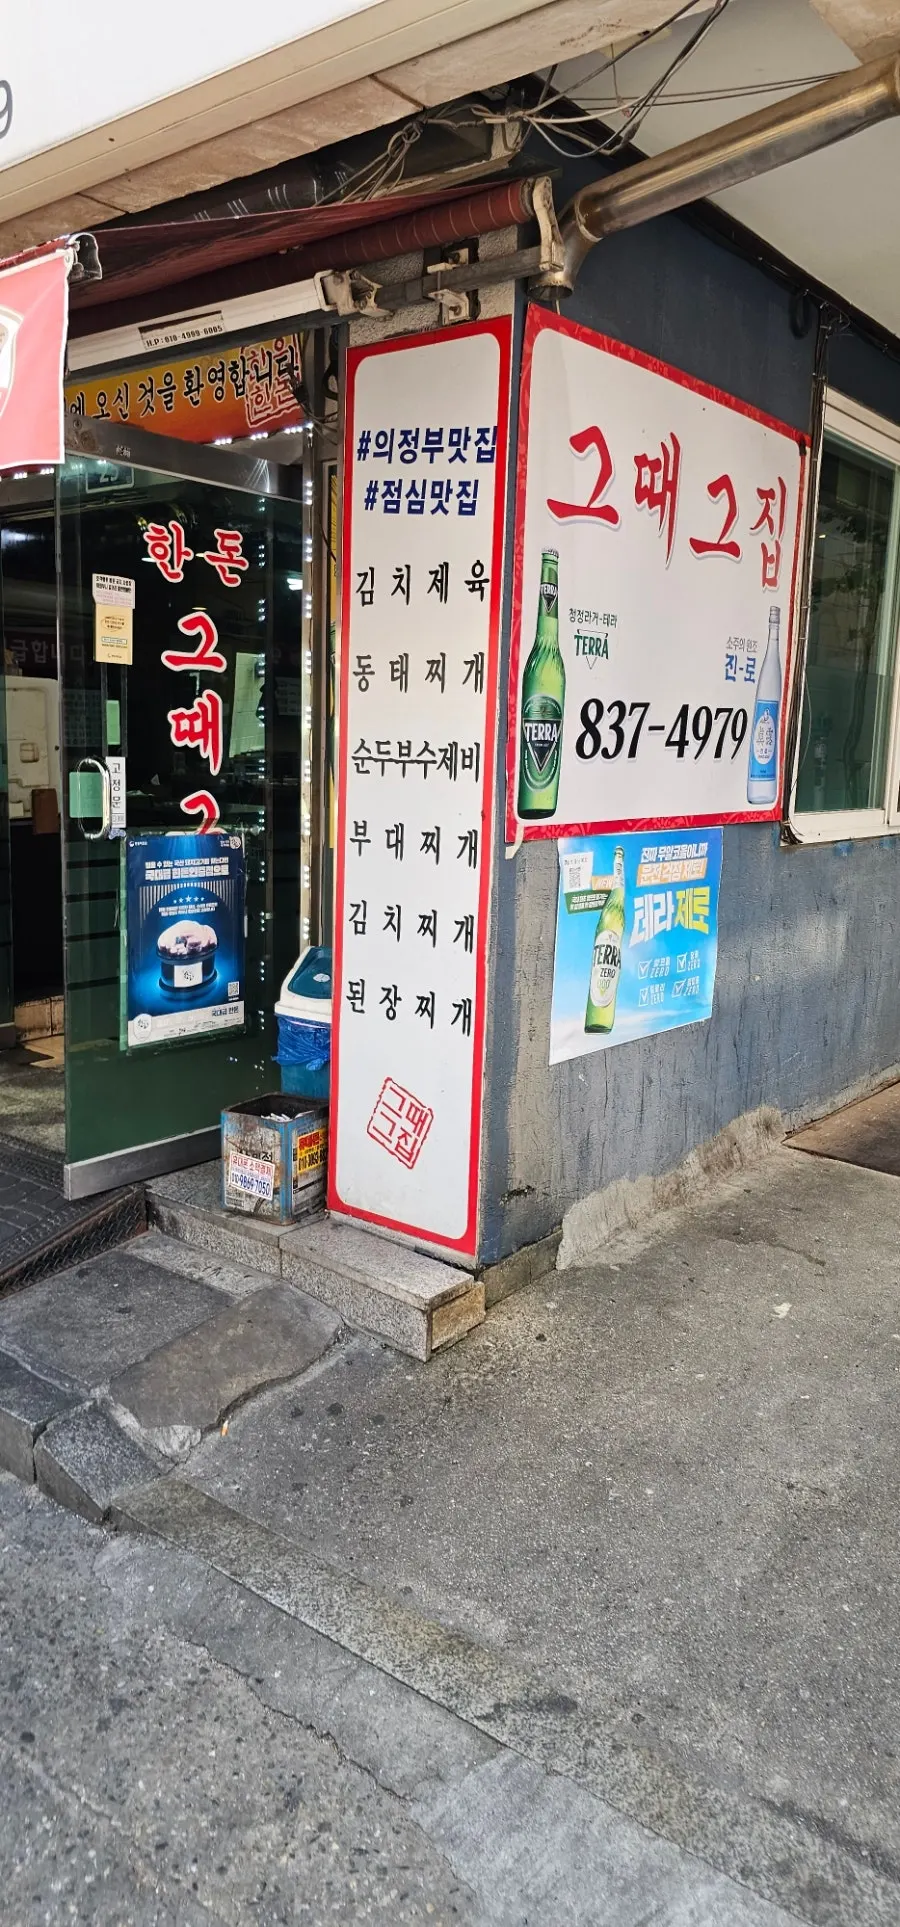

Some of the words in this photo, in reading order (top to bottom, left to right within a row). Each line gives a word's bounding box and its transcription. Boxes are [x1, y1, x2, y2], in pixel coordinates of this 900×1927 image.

[92, 380, 131, 421] 오신
[137, 371, 178, 418] 것을
[356, 424, 499, 465] #의정부맛집
[363, 478, 480, 517] #점심맛집
[573, 634, 609, 660] TERRA
[725, 635, 744, 653] 소주의
[524, 721, 559, 743] TERRA
[575, 697, 749, 761] 837-4979
[351, 738, 482, 784] 순두부수제비
[629, 891, 675, 948] 테라
[674, 886, 710, 935] 제로
[593, 944, 621, 970] TERRA
[600, 967, 616, 979] ZERO
[650, 966, 670, 978] ZERO
